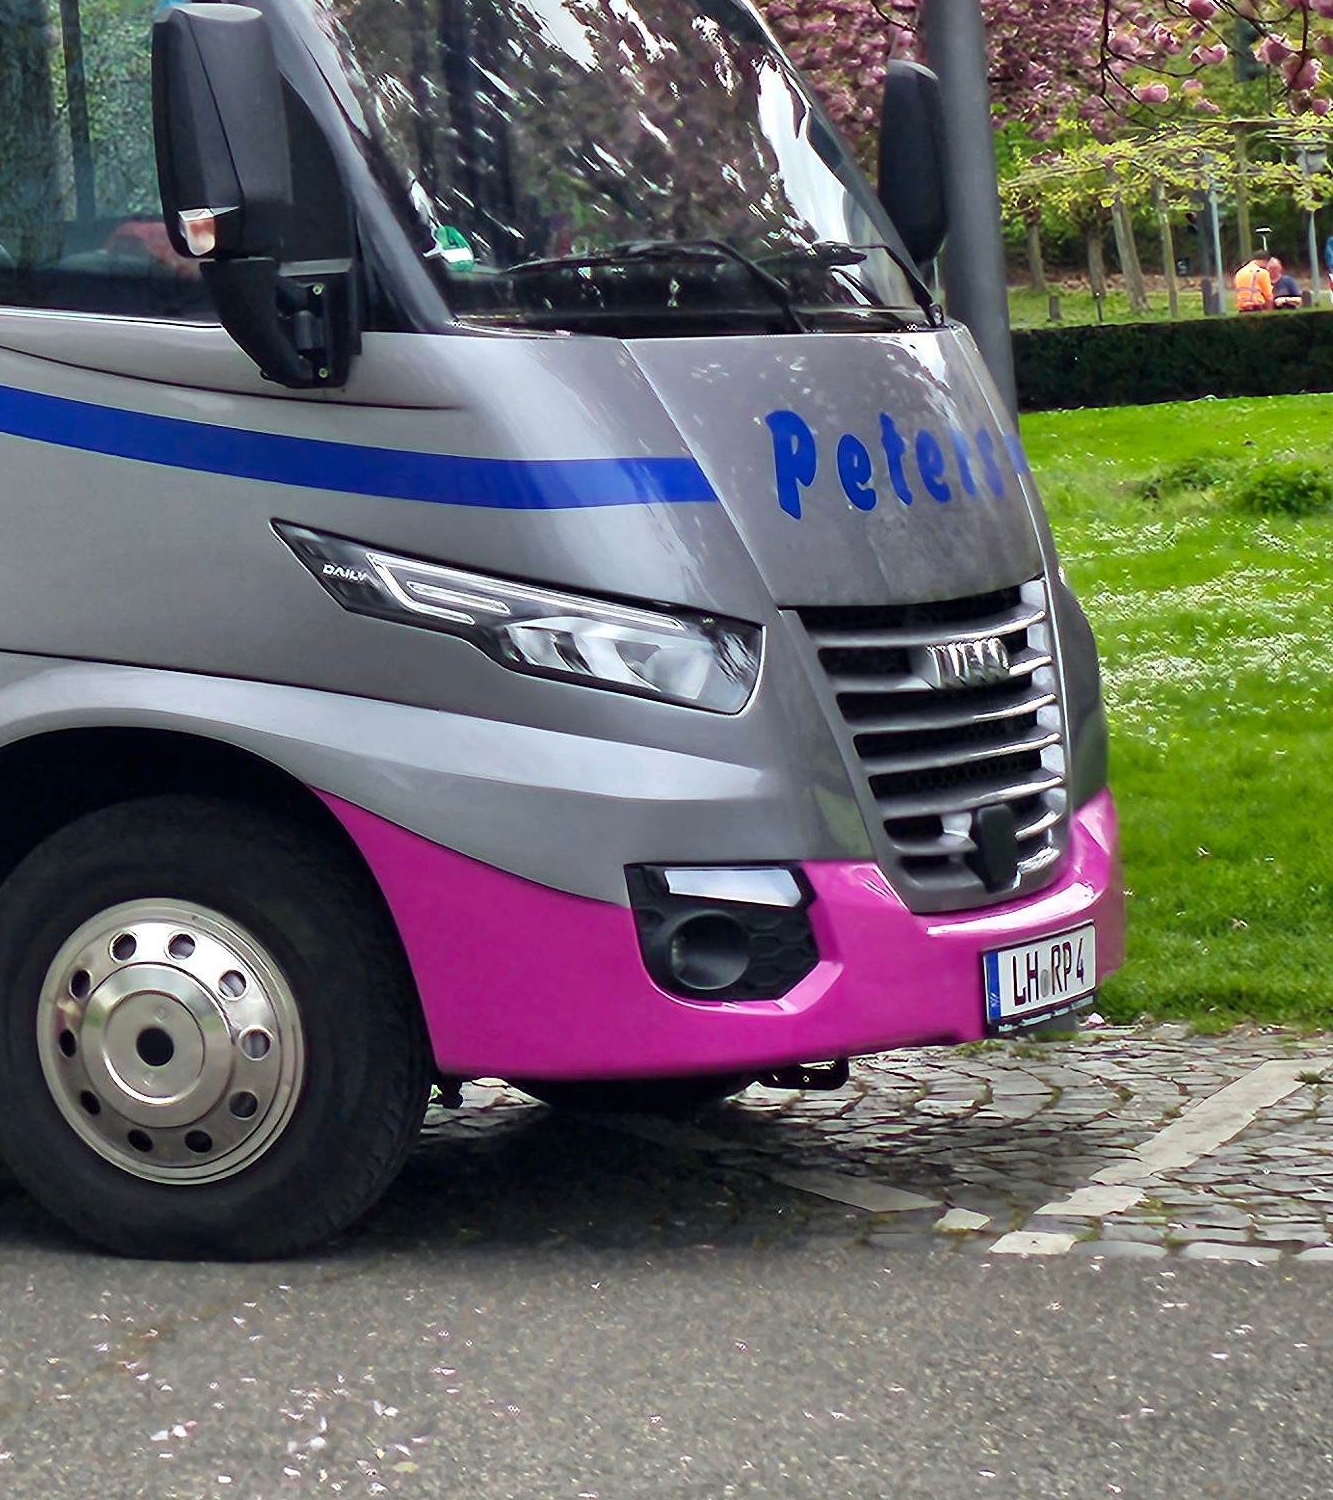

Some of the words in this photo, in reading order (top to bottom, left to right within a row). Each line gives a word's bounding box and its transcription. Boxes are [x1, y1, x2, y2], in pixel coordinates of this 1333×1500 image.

[764, 409, 1007, 521] Peters
[322, 563, 367, 582] DAILY
[1012, 950, 1040, 1007] LH
